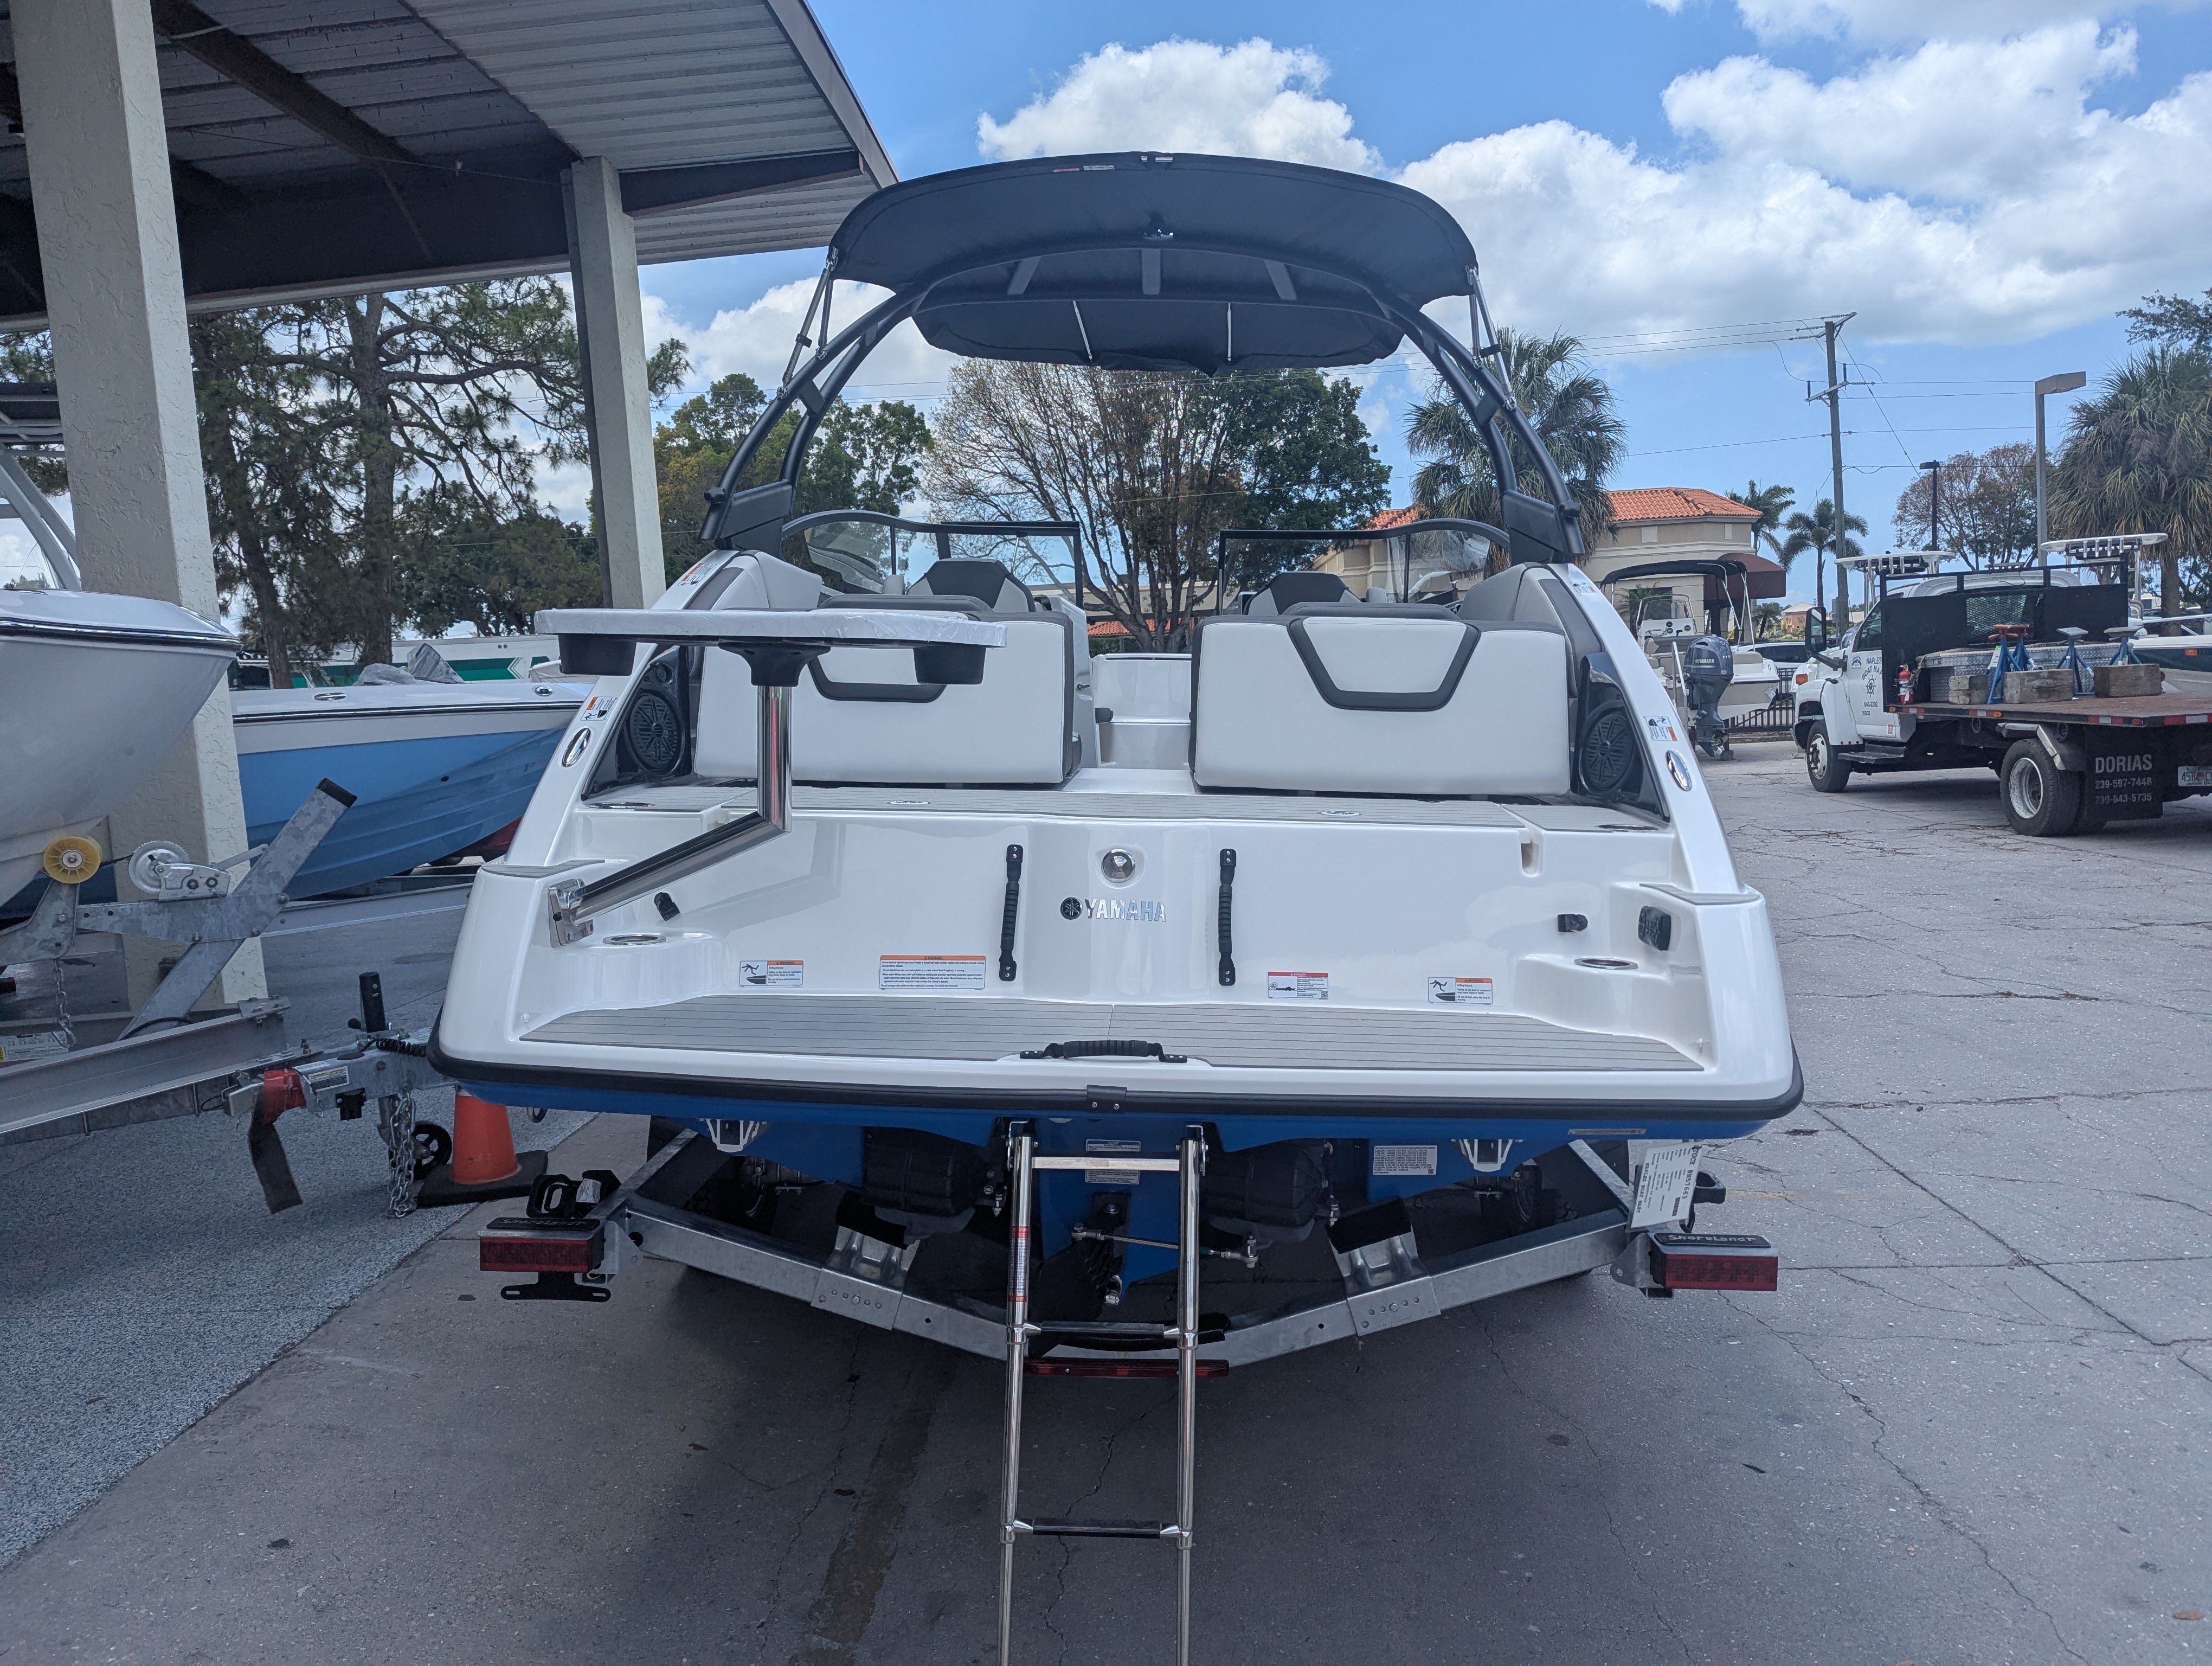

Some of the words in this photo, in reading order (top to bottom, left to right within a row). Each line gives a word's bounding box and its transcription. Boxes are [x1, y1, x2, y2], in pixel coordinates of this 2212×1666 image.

[1861, 666, 1872, 681] BOAT
[2095, 754, 2152, 773] DORIAS
[2095, 777, 2152, 789] 239-597-7448
[2095, 793, 2152, 805] 239-643-5735
[1084, 898, 1167, 922] YAMAHA
